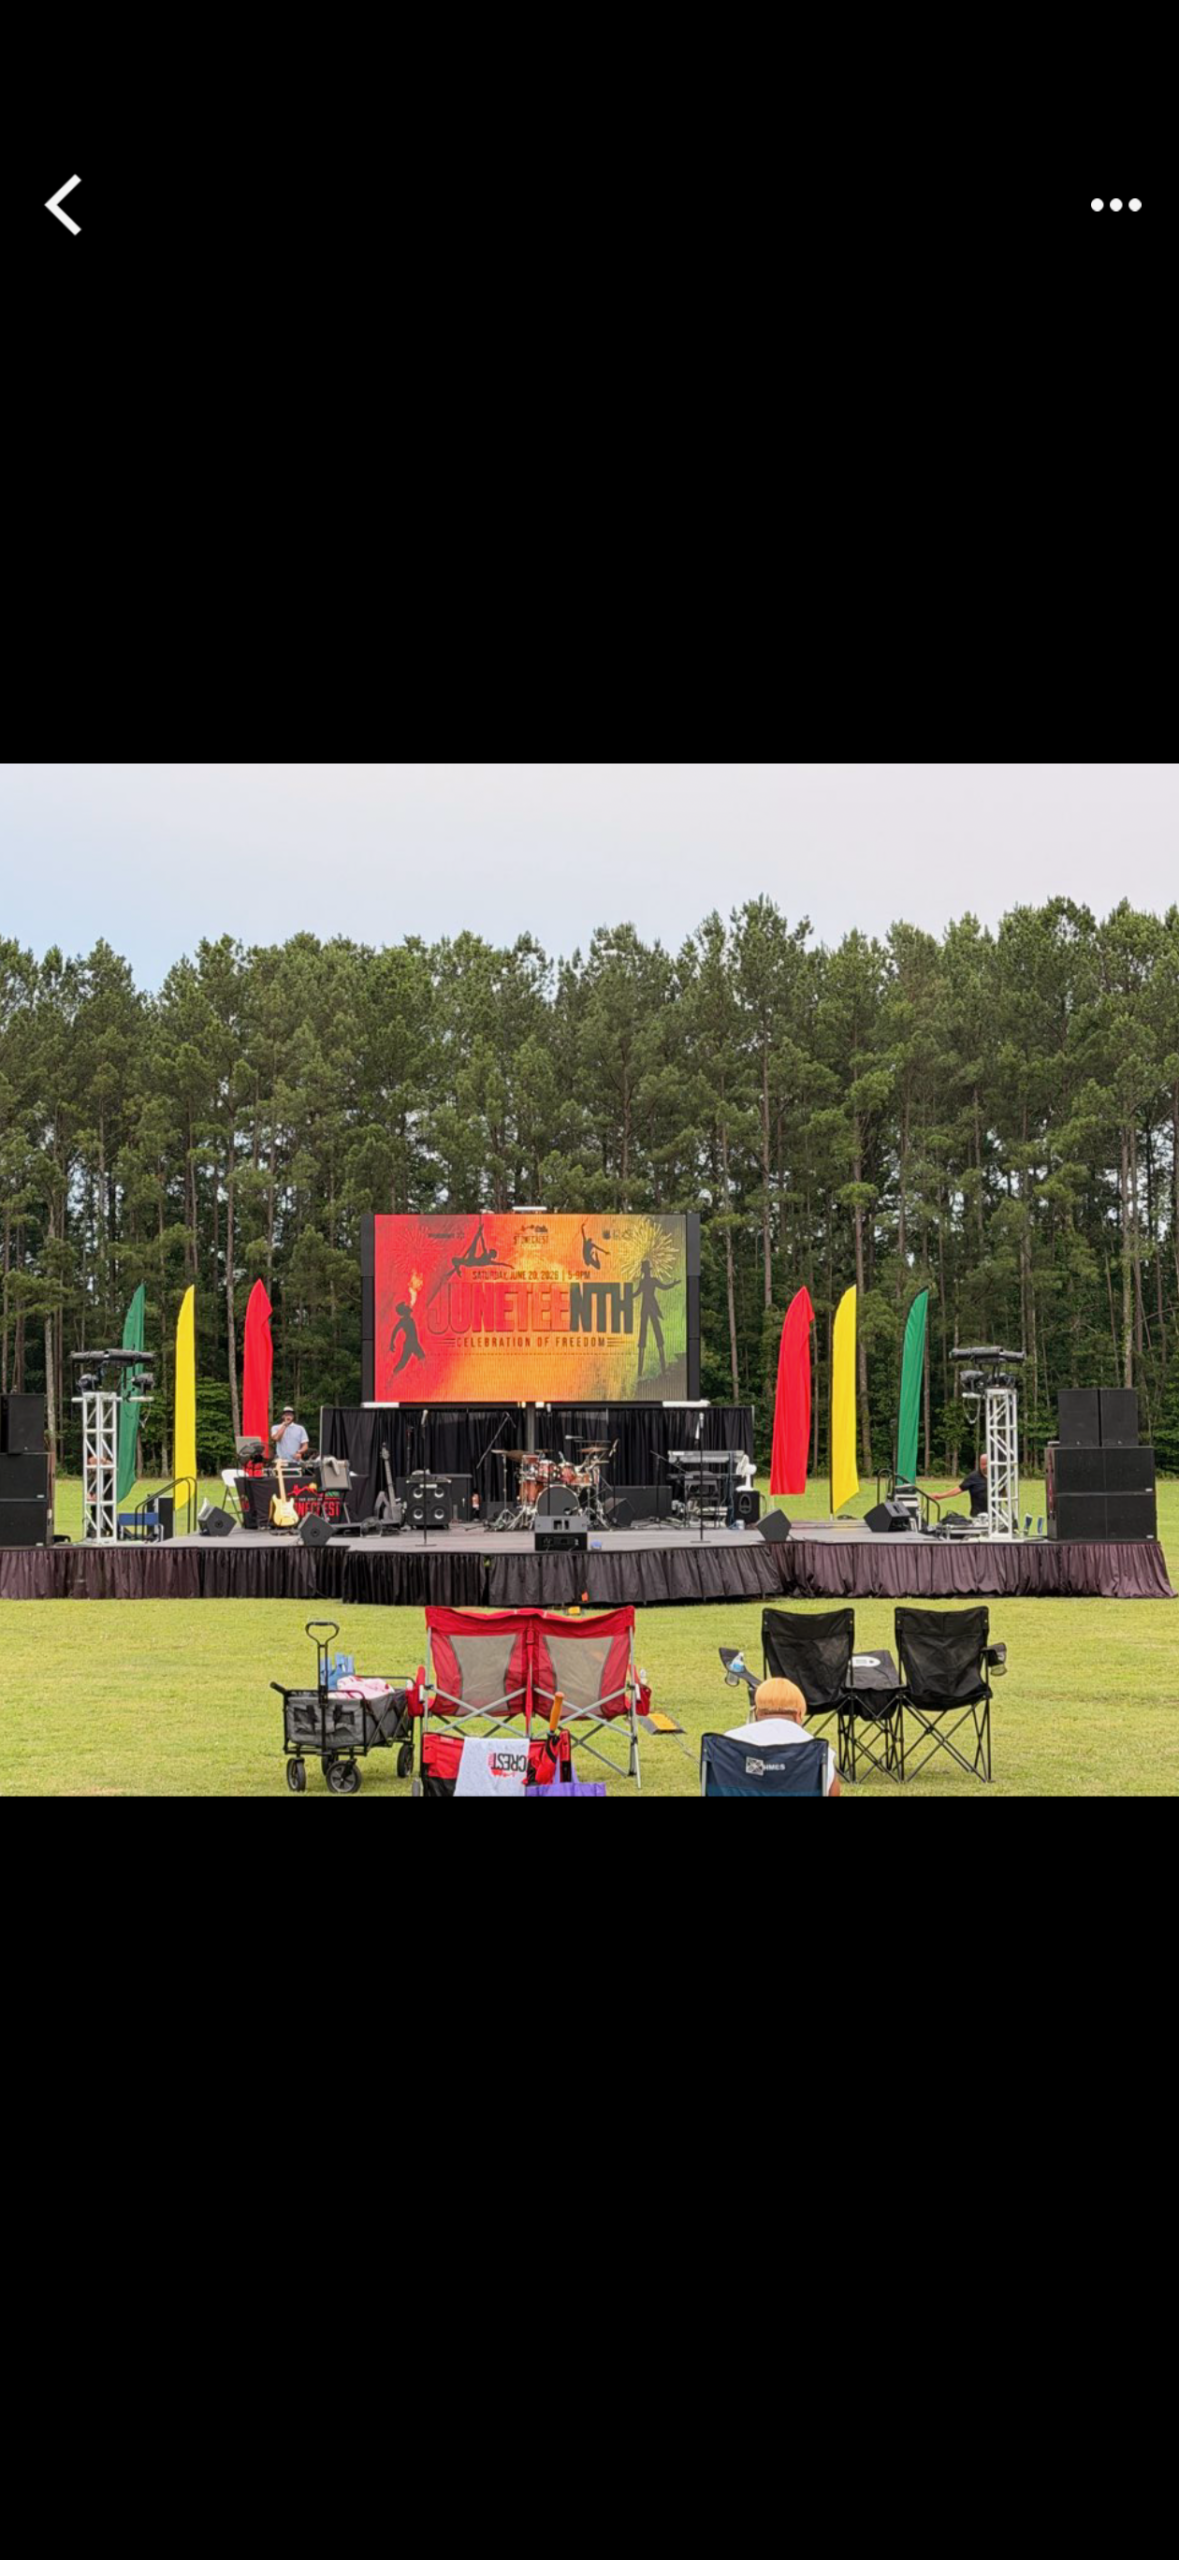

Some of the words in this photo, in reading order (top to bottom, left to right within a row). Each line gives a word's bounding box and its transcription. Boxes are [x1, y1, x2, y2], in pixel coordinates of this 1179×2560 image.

[510, 1270, 526, 1280] JUNE
[427, 1282, 633, 1334] JUNETEENTH
[456, 1336, 531, 1348] CELEBRATION
[537, 1336, 549, 1348] OF
[555, 1336, 607, 1348] FREEDOM
[490, 1753, 527, 1773] CREST
